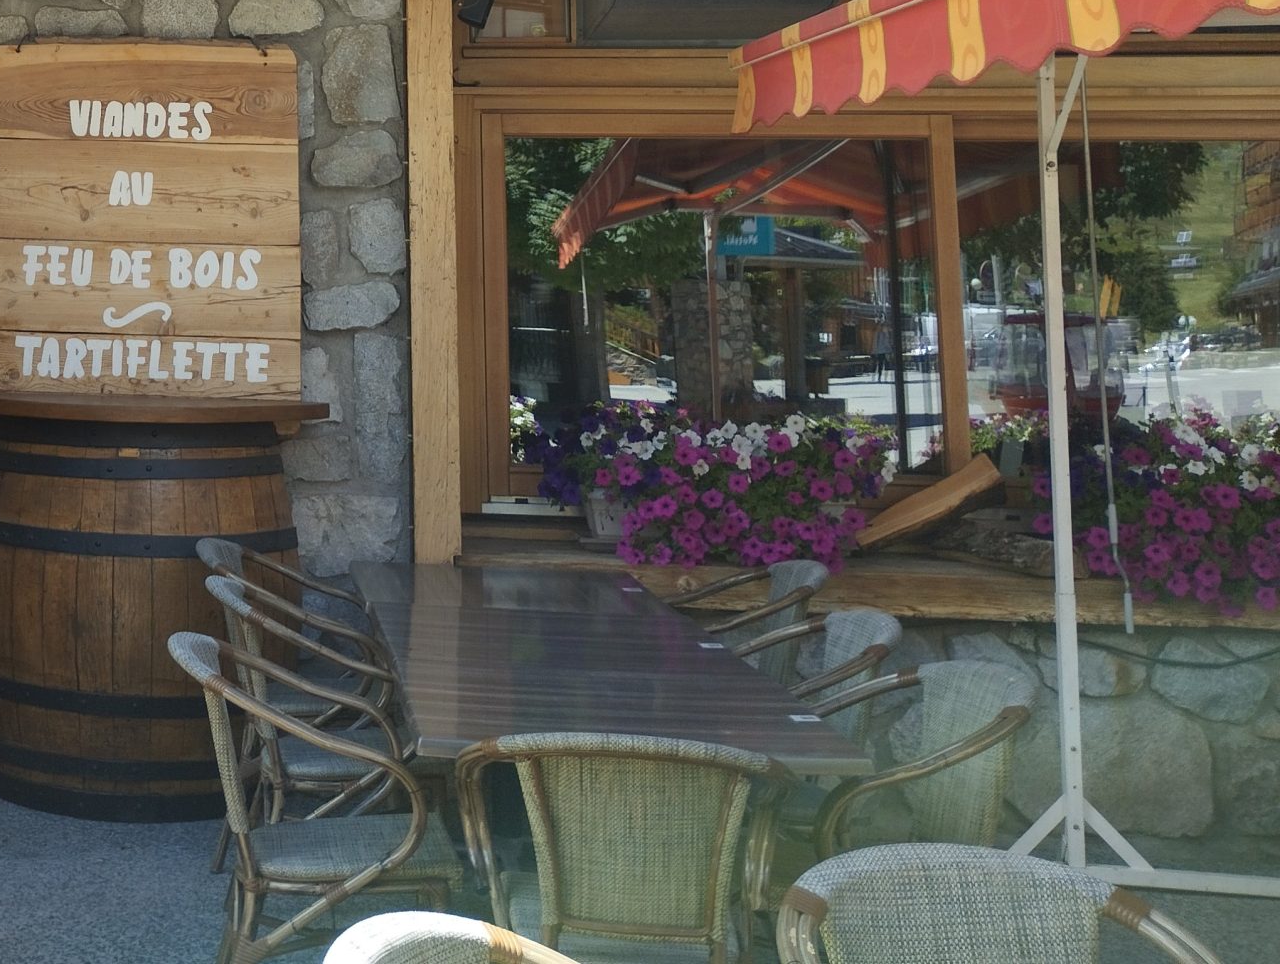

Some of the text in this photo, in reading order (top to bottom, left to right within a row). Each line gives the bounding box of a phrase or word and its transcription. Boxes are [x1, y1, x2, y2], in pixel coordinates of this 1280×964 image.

[69, 100, 213, 140] VIANDES
[108, 171, 154, 206] AU
[22, 245, 262, 290] FEU DE BOIS
[15, 335, 270, 383] TARTIFLETTE
